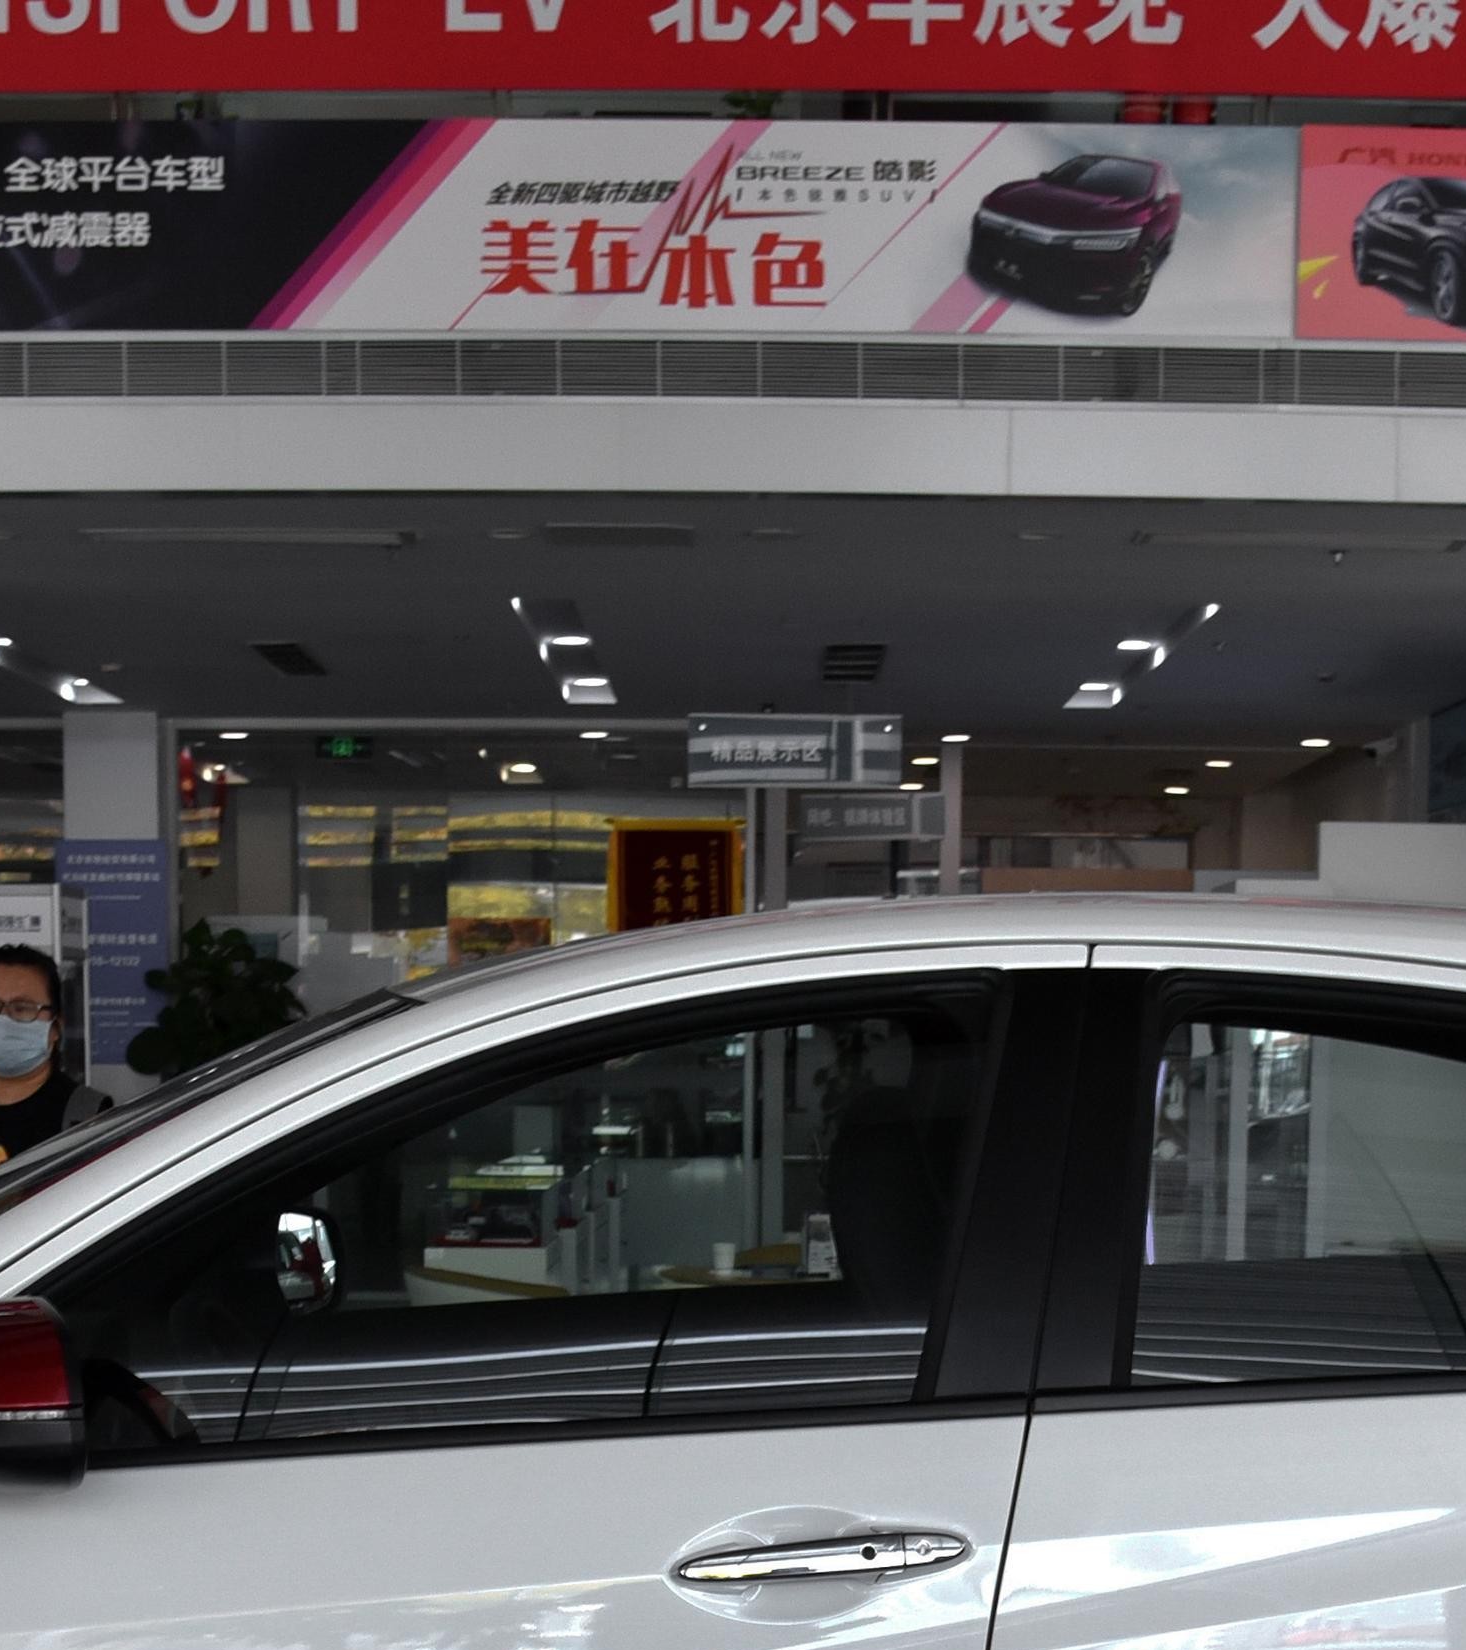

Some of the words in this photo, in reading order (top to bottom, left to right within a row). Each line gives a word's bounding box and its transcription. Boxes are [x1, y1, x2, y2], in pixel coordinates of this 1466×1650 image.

[4, 155, 225, 193] 全球平台车型
[736, 166, 865, 181] BREEZE
[873, 160, 936, 182] 皓影
[485, 180, 682, 206] 全新四驱城市越野
[481, 219, 828, 309] 美在本色
[711, 740, 823, 763] 精品展示区
